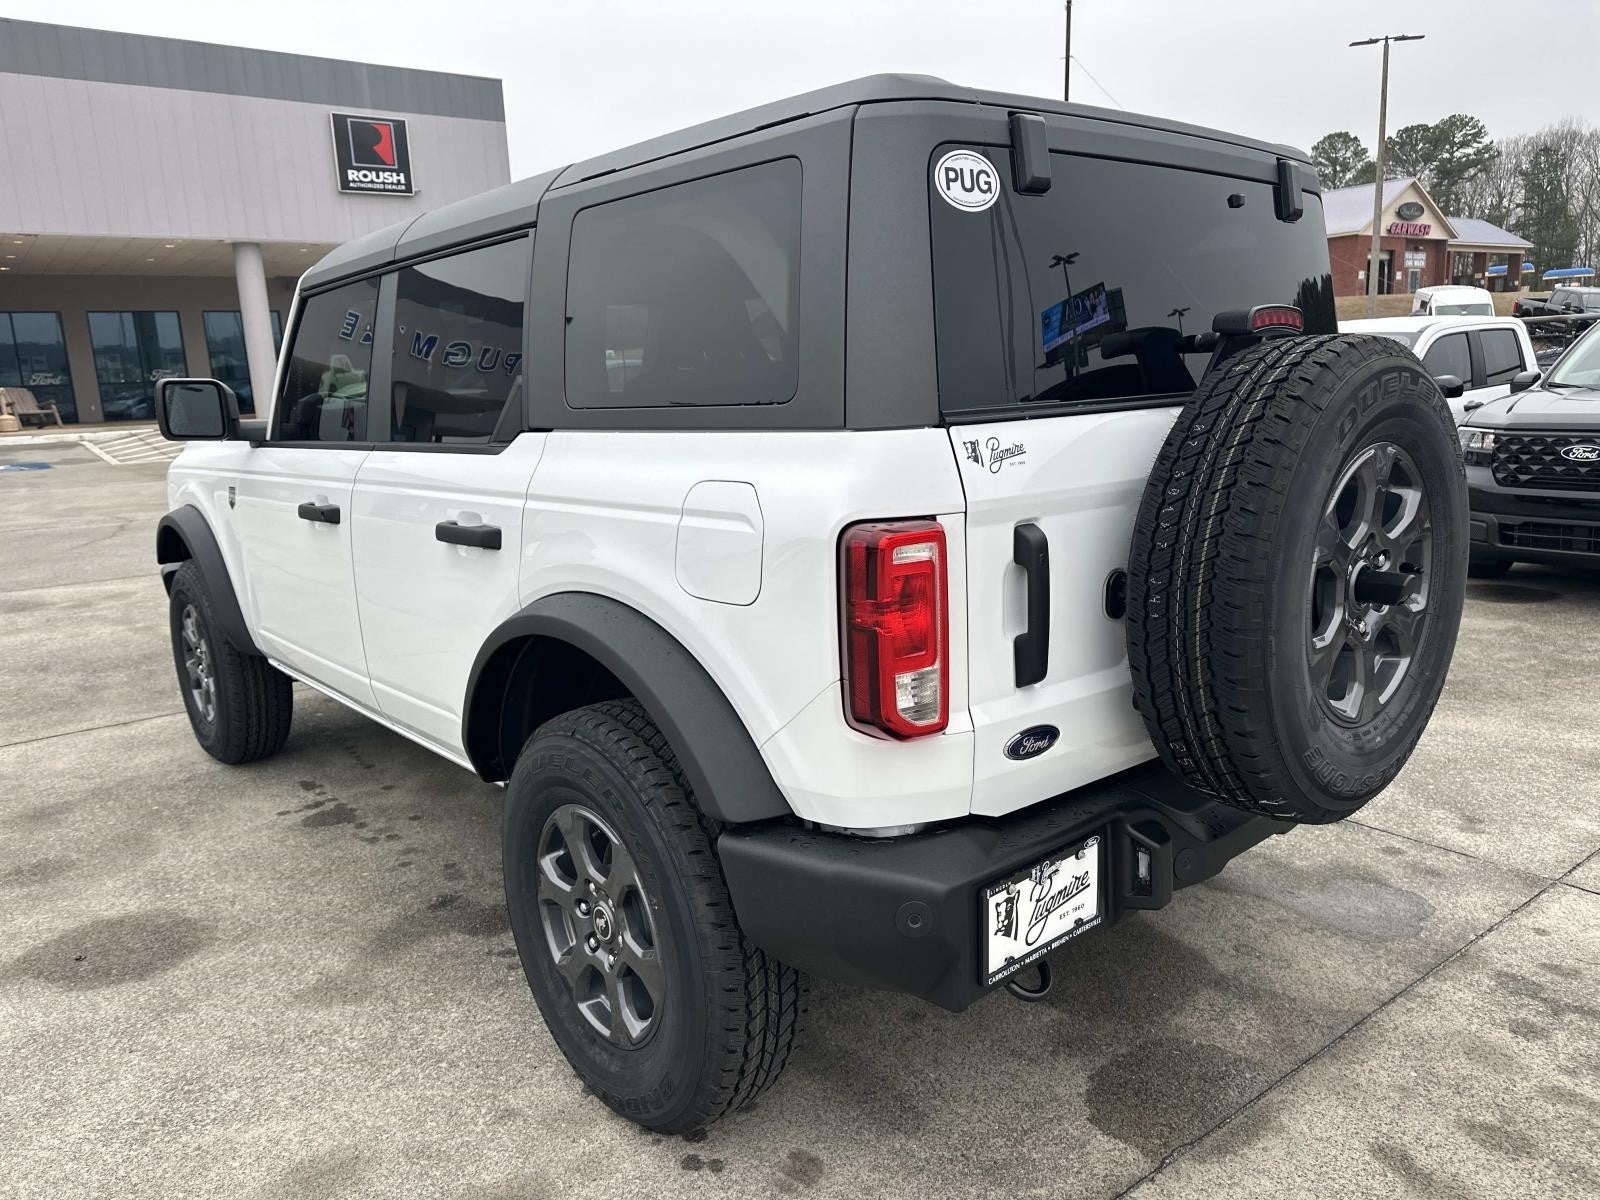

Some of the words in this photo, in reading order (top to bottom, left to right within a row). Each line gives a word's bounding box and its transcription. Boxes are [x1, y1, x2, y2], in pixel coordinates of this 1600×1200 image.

[347, 169, 406, 184] ROUSH
[944, 166, 993, 195] PUG
[30, 373, 62, 385] Ford
[986, 436, 1027, 474] Pugmire
[1569, 447, 1599, 459] Ford
[1019, 735, 1050, 755] Ford
[1025, 870, 1091, 946] Pugmire
[988, 962, 1021, 985] CARROLLTON
[1024, 948, 1048, 966] MARIETTA
[1073, 917, 1102, 937] CARTERSVILLE
